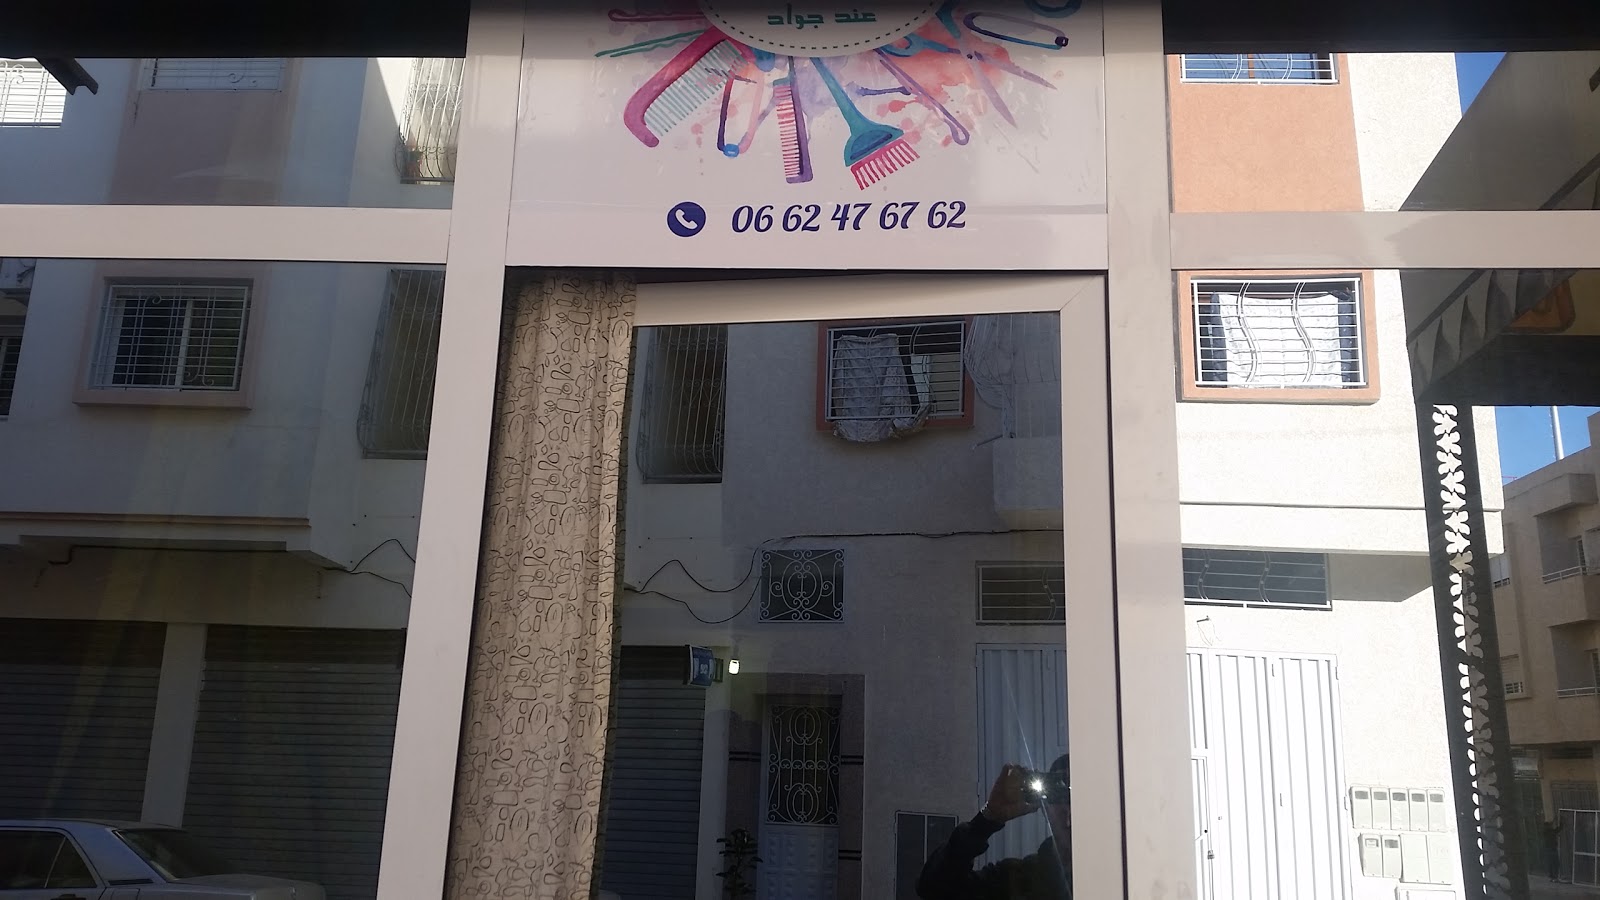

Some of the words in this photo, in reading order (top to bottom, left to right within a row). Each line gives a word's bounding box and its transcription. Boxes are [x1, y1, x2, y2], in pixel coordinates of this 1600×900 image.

[767, 3, 825, 30] جواد
[835, 9, 877, 23] عند
[732, 204, 775, 233] 06
[782, 203, 822, 233] 62
[831, 202, 873, 231] 47
[879, 201, 921, 230] 67
[927, 200, 967, 229] 62
